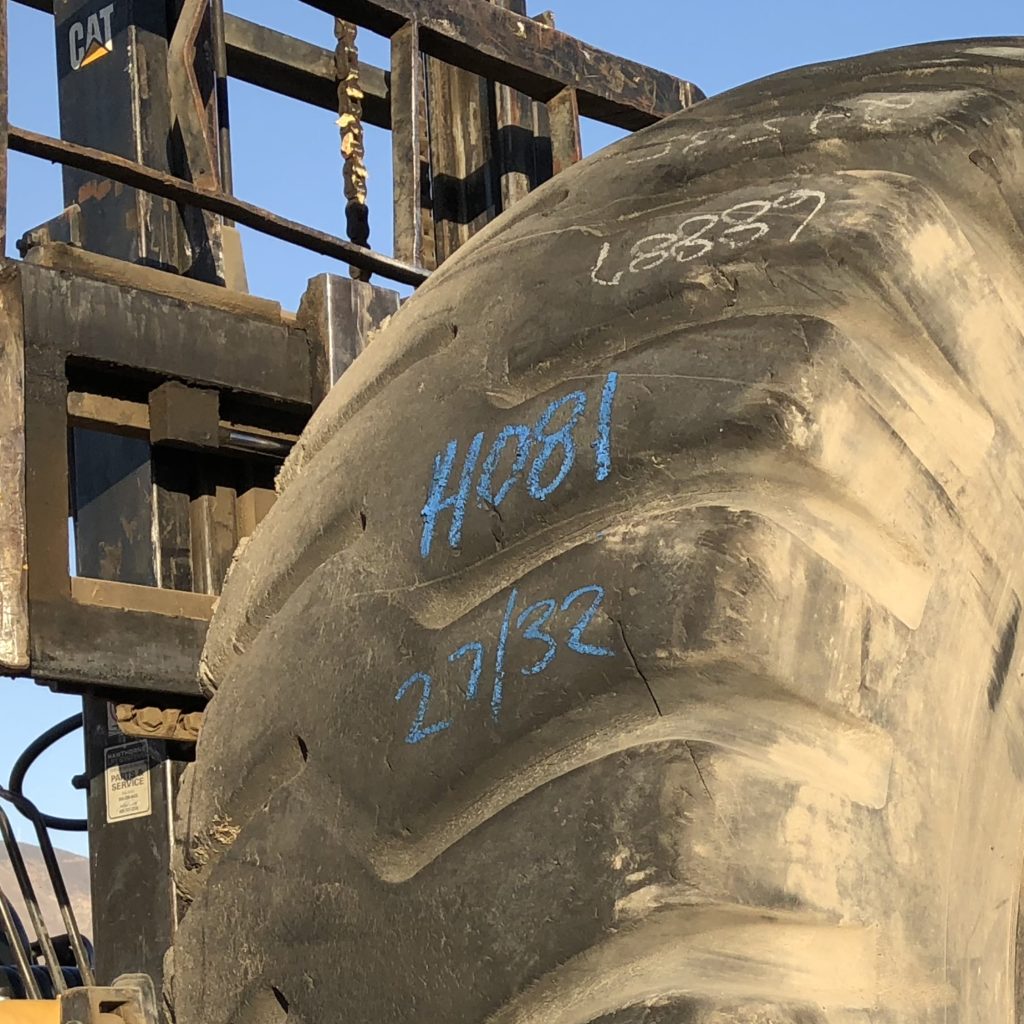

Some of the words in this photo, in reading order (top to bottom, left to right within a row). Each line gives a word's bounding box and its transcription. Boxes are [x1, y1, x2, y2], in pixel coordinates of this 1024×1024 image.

[69, 3, 113, 70] CAT
[420, 371, 618, 558] H081
[395, 584, 615, 744] 27/32
[112, 777, 145, 791] SERVICE
